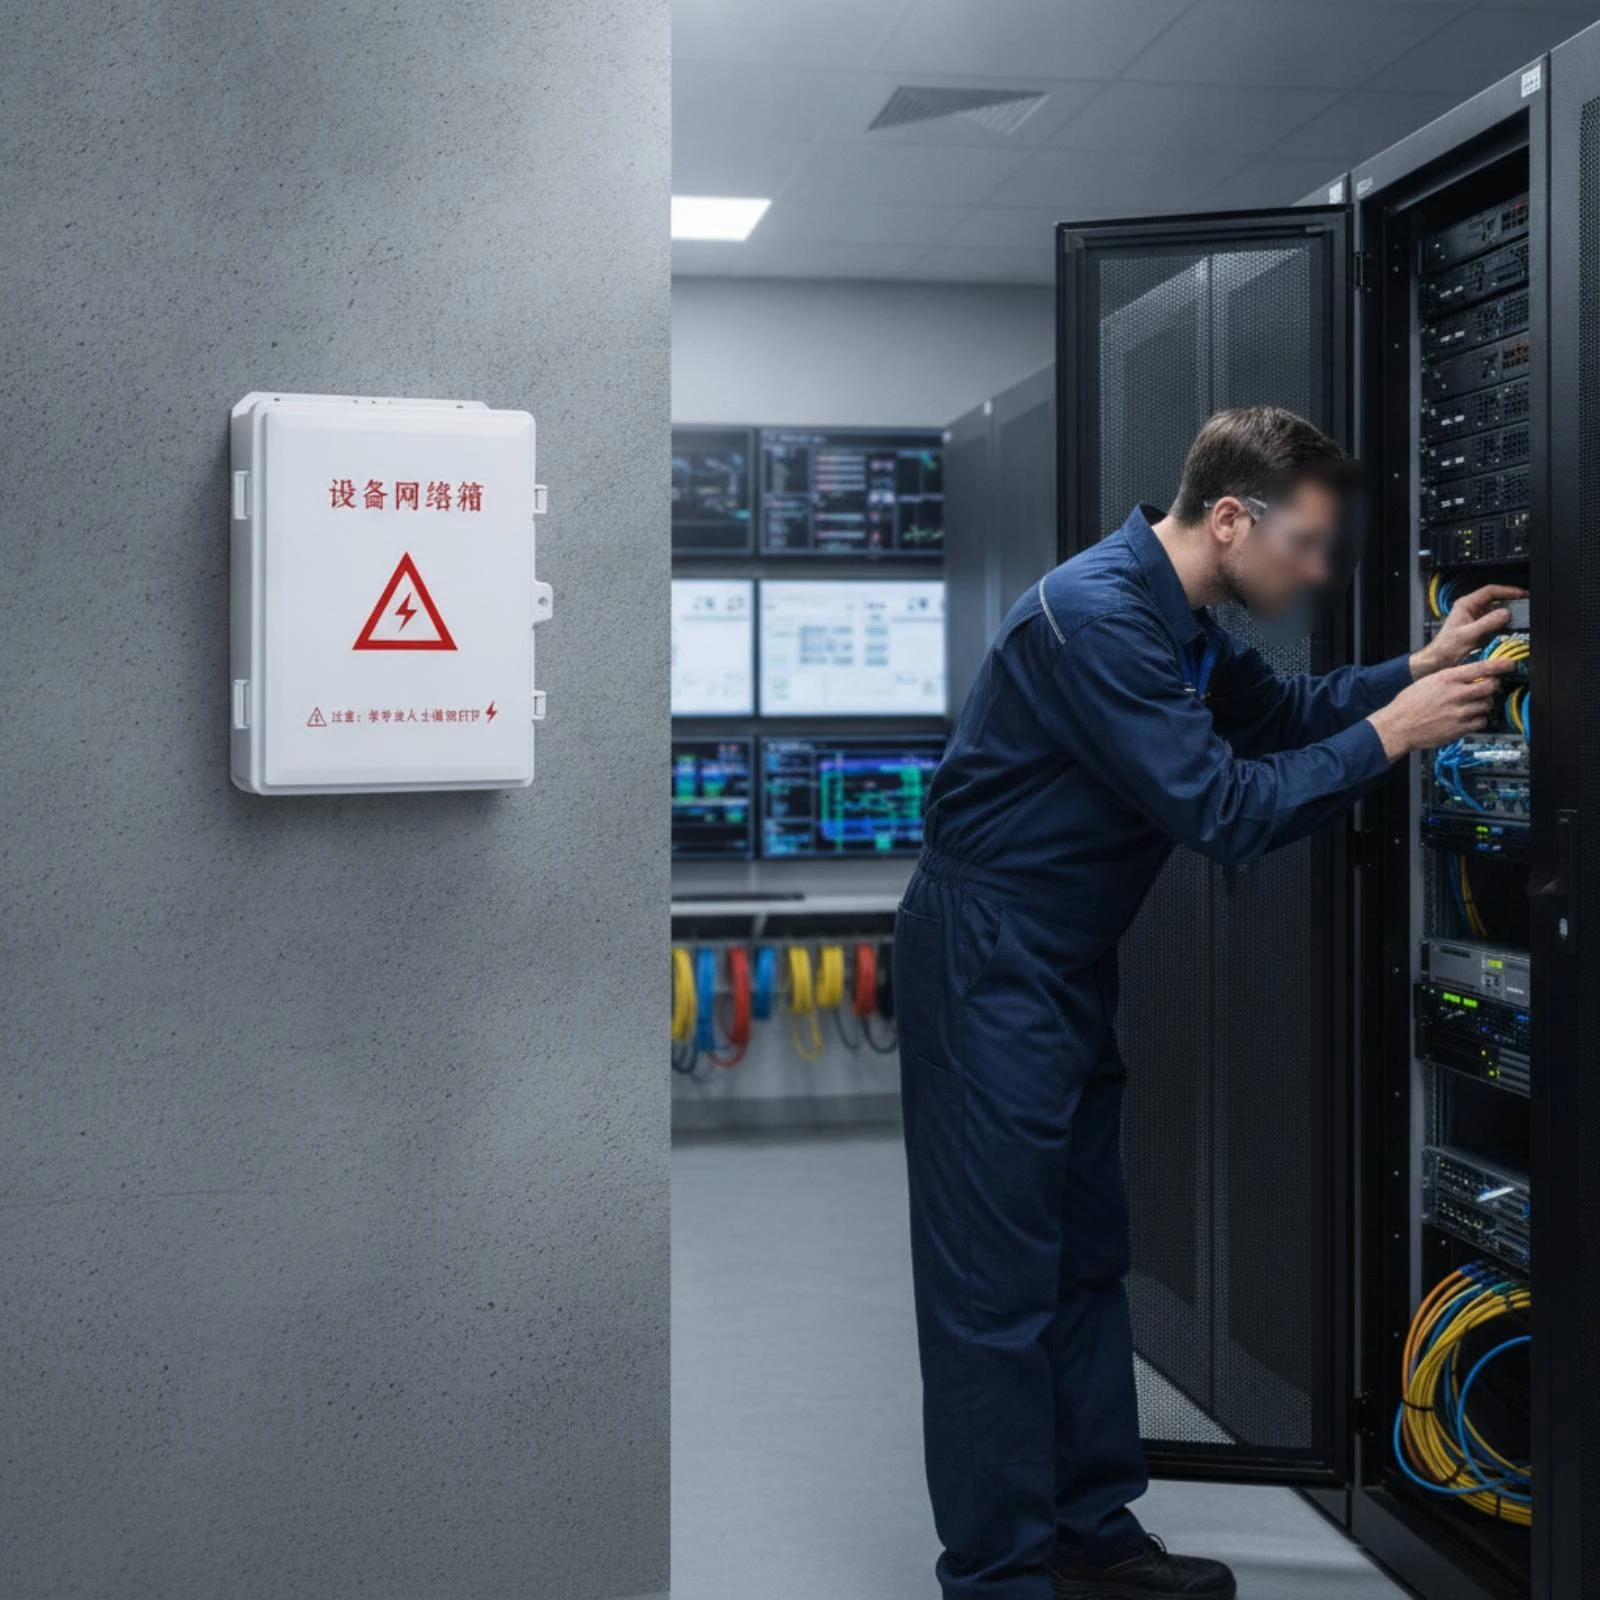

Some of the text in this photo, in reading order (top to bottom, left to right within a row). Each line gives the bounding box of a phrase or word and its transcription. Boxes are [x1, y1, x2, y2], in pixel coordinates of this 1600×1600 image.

[329, 478, 484, 513] 设备网络箱
